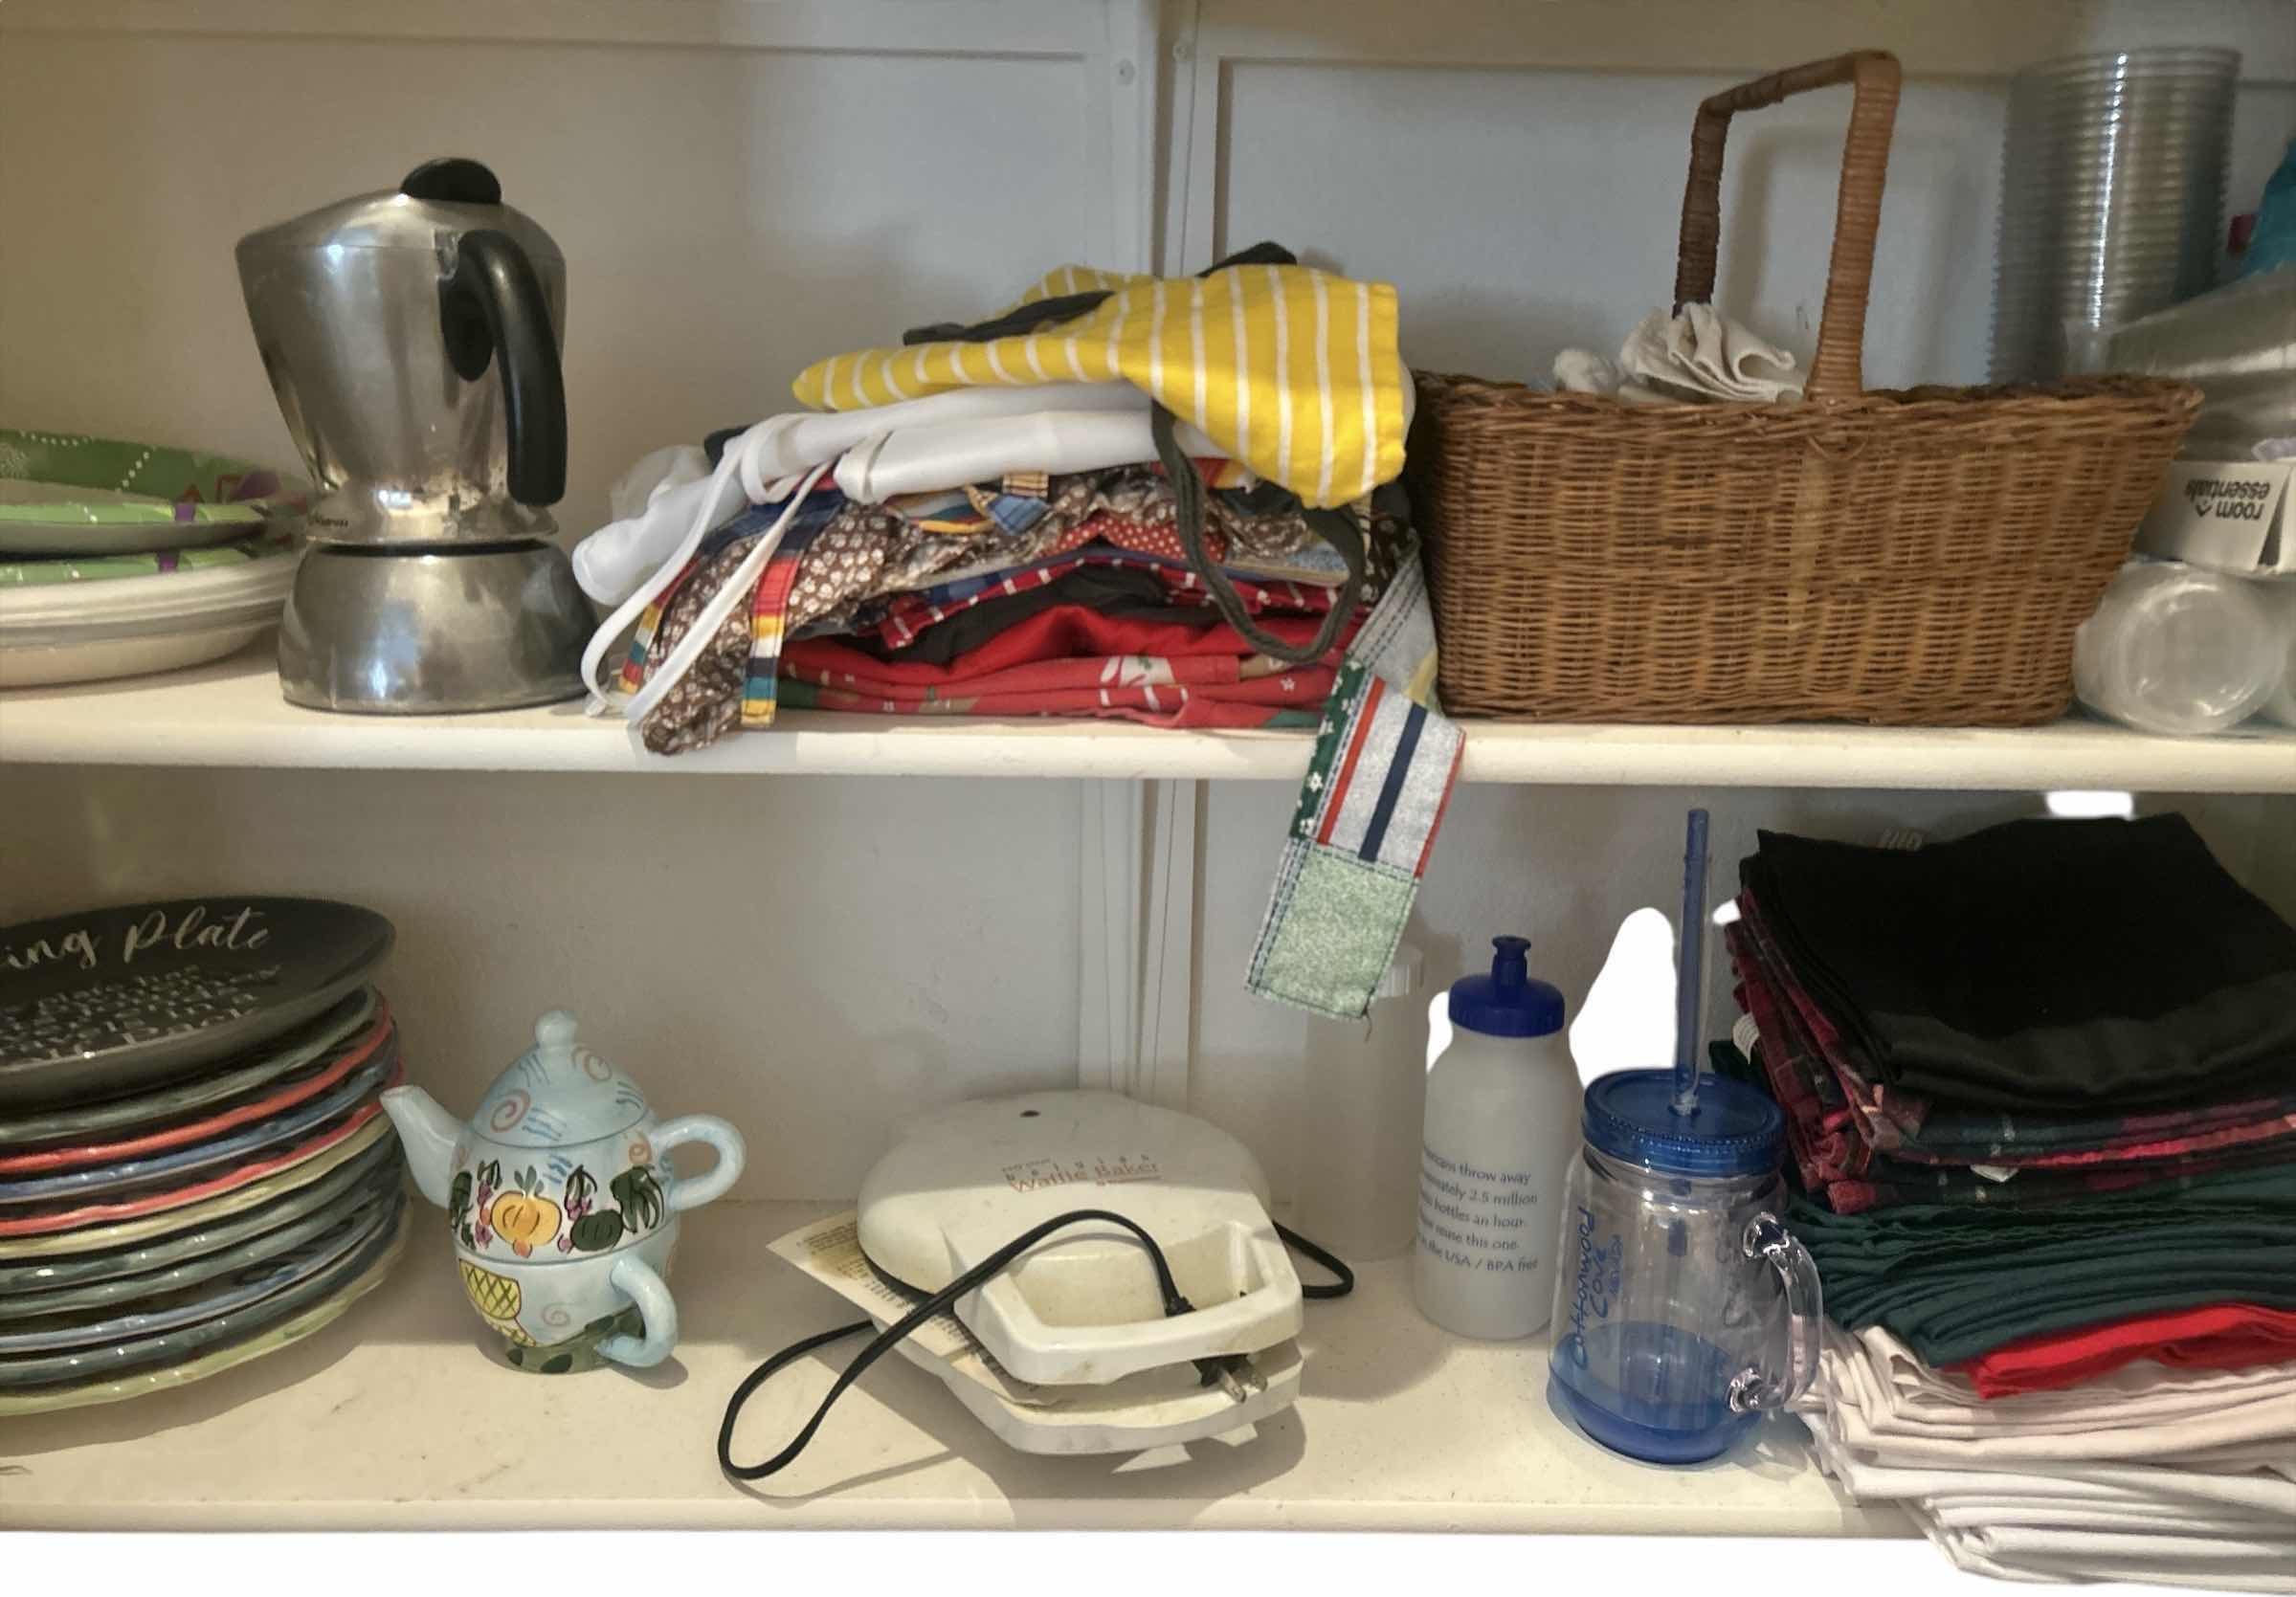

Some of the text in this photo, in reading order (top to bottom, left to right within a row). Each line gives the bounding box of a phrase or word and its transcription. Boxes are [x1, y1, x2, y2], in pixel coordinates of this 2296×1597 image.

[2184, 479, 2270, 504] essentials
[2216, 501, 2264, 521] room
[0, 925, 99, 970] ing
[1460, 1163, 1496, 1182] throw
[1500, 1172, 1531, 1187] away
[1469, 1188, 1490, 1204] 2.5
[1493, 1190, 1538, 1207] million
[1434, 1197, 1470, 1222] bottles
[1473, 1215, 1489, 1226] an
[1466, 1232, 1488, 1248] this
[1445, 1250, 1471, 1268] USA
[1487, 1259, 1513, 1273] BPA
[1518, 1256, 1539, 1272] free
[1570, 1206, 1594, 1370] Cottonwood
[1589, 1247, 1608, 1319] Cove
